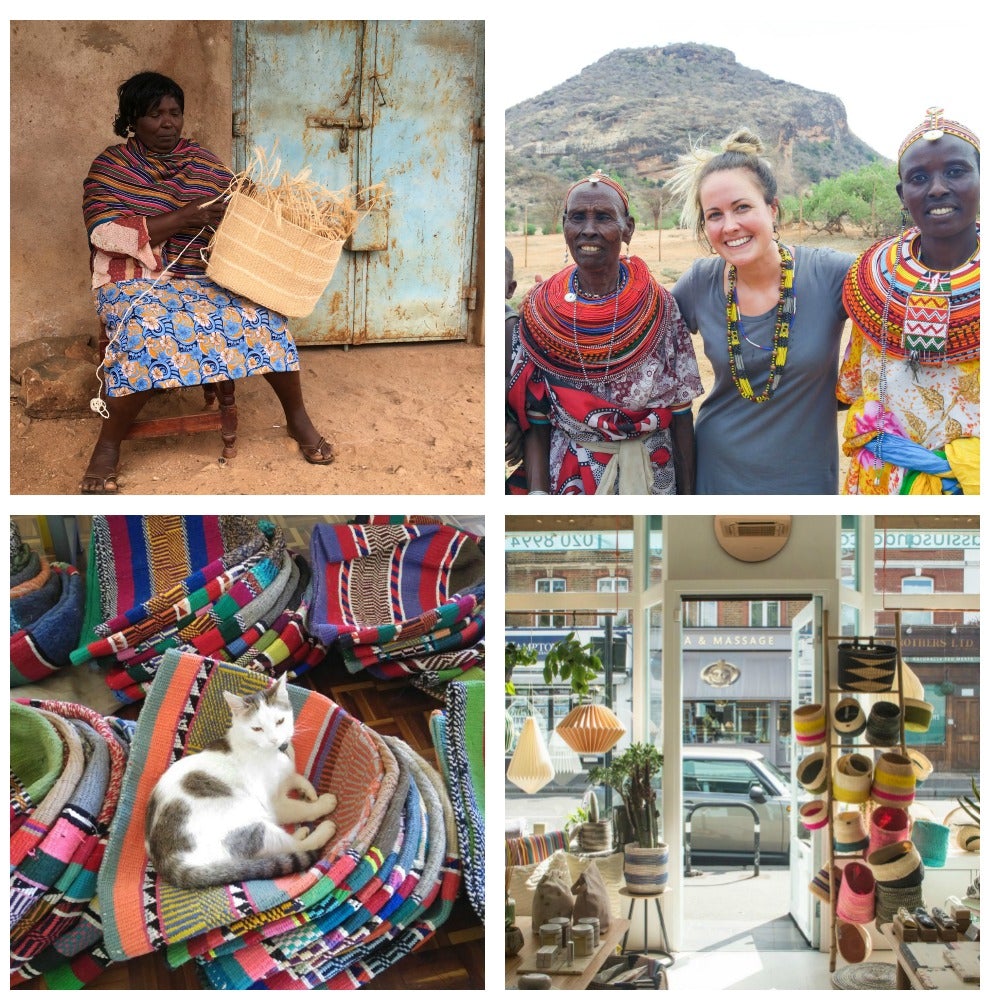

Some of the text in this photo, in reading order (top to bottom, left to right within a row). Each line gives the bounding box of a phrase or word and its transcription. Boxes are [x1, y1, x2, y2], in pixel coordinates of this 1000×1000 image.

[698, 636, 706, 645] &
[713, 636, 775, 645] MASSAGE
[892, 639, 947, 648] OTHERS
[951, 639, 974, 648] LTD
